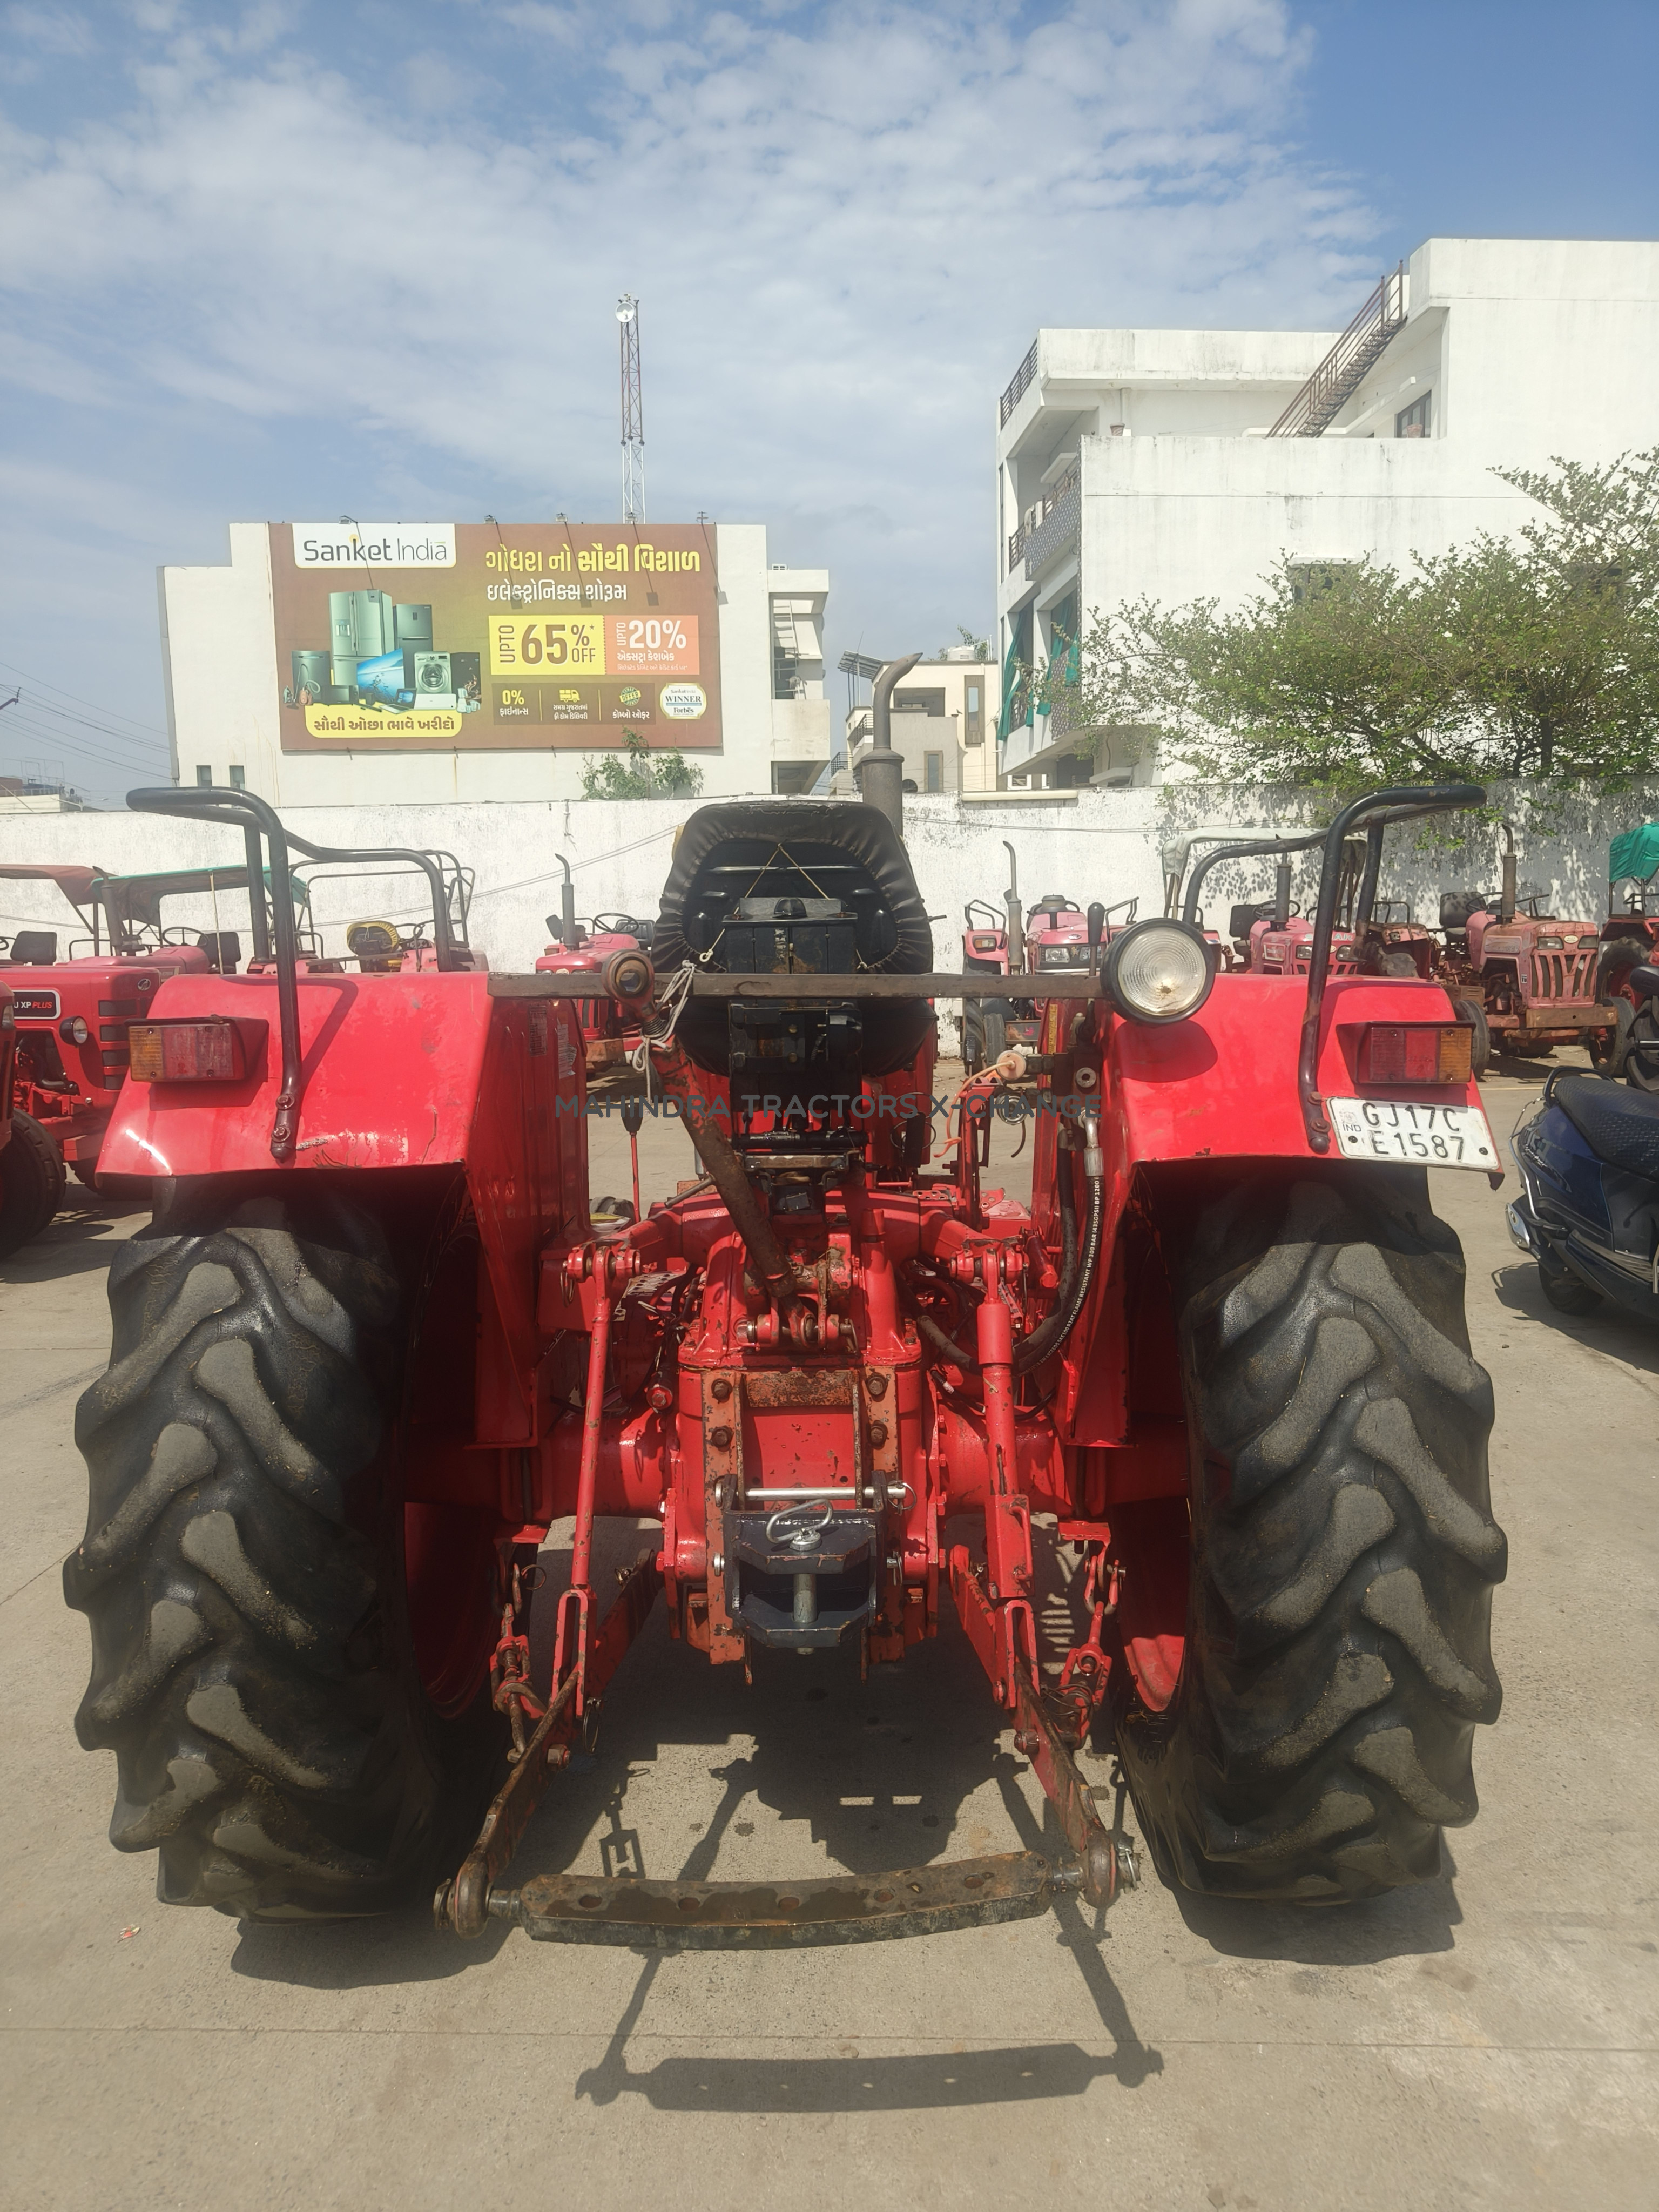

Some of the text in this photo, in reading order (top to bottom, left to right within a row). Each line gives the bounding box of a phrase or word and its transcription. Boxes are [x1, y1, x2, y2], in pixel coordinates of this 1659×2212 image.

[304, 538, 447, 561] Sanket India
[485, 543, 701, 572] ગોધરા નો સૌથી વિશાળ
[498, 625, 516, 663] UPTO
[616, 622, 627, 646] UPTO
[629, 619, 687, 649] 20%
[571, 648, 596, 663] OFF
[502, 690, 525, 705] 0%
[622, 691, 639, 701] OFFER
[314, 715, 454, 731] સૌથી ઓછા ભાવે ખરીદો
[1343, 1124, 1361, 1132] IND
[1362, 1102, 1460, 1132] GJ17C
[1370, 1130, 1465, 1162] E1587
[1073, 1297, 1083, 1315] FLAME
[1079, 1269, 1091, 1298] RESISTANT
[1087, 1258, 1092, 1268] WP
[1094, 1196, 1100, 1204] BP
